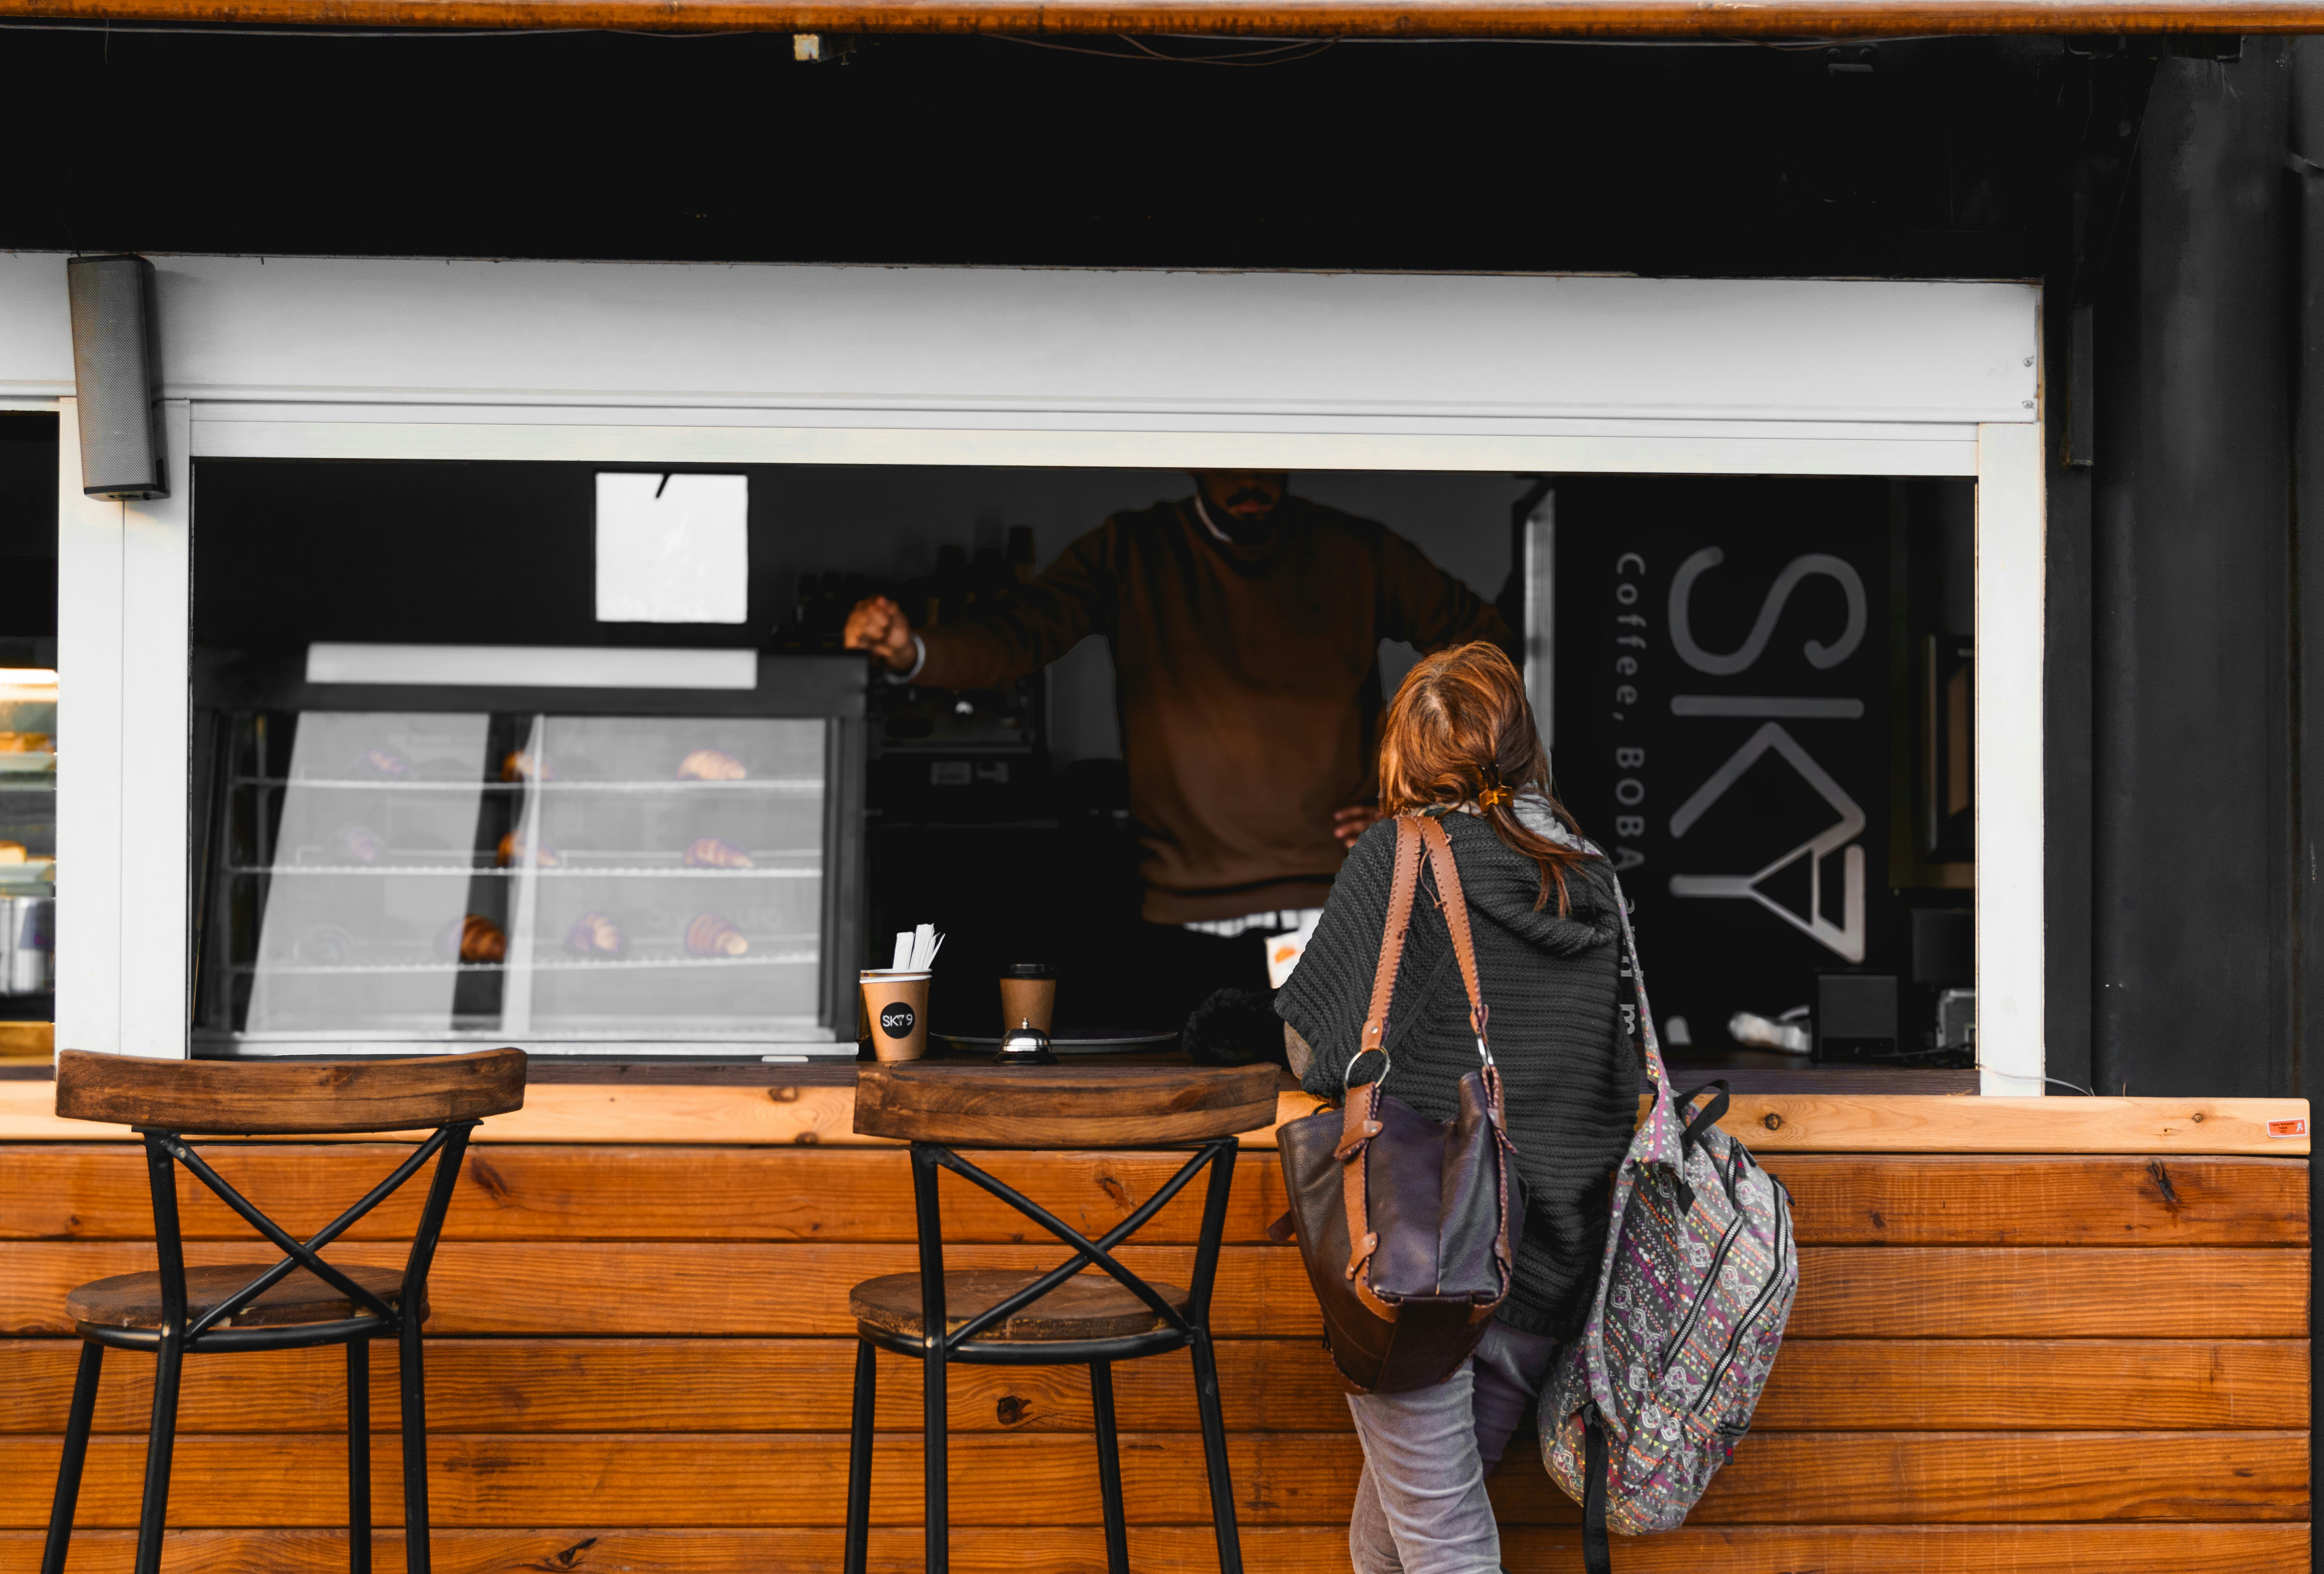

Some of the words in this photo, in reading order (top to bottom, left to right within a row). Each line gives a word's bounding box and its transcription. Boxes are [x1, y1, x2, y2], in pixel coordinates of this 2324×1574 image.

[1613, 552, 1646, 721] Coffee,
[1615, 746, 1645, 871] BOBA
[1668, 545, 1868, 964] SKY
